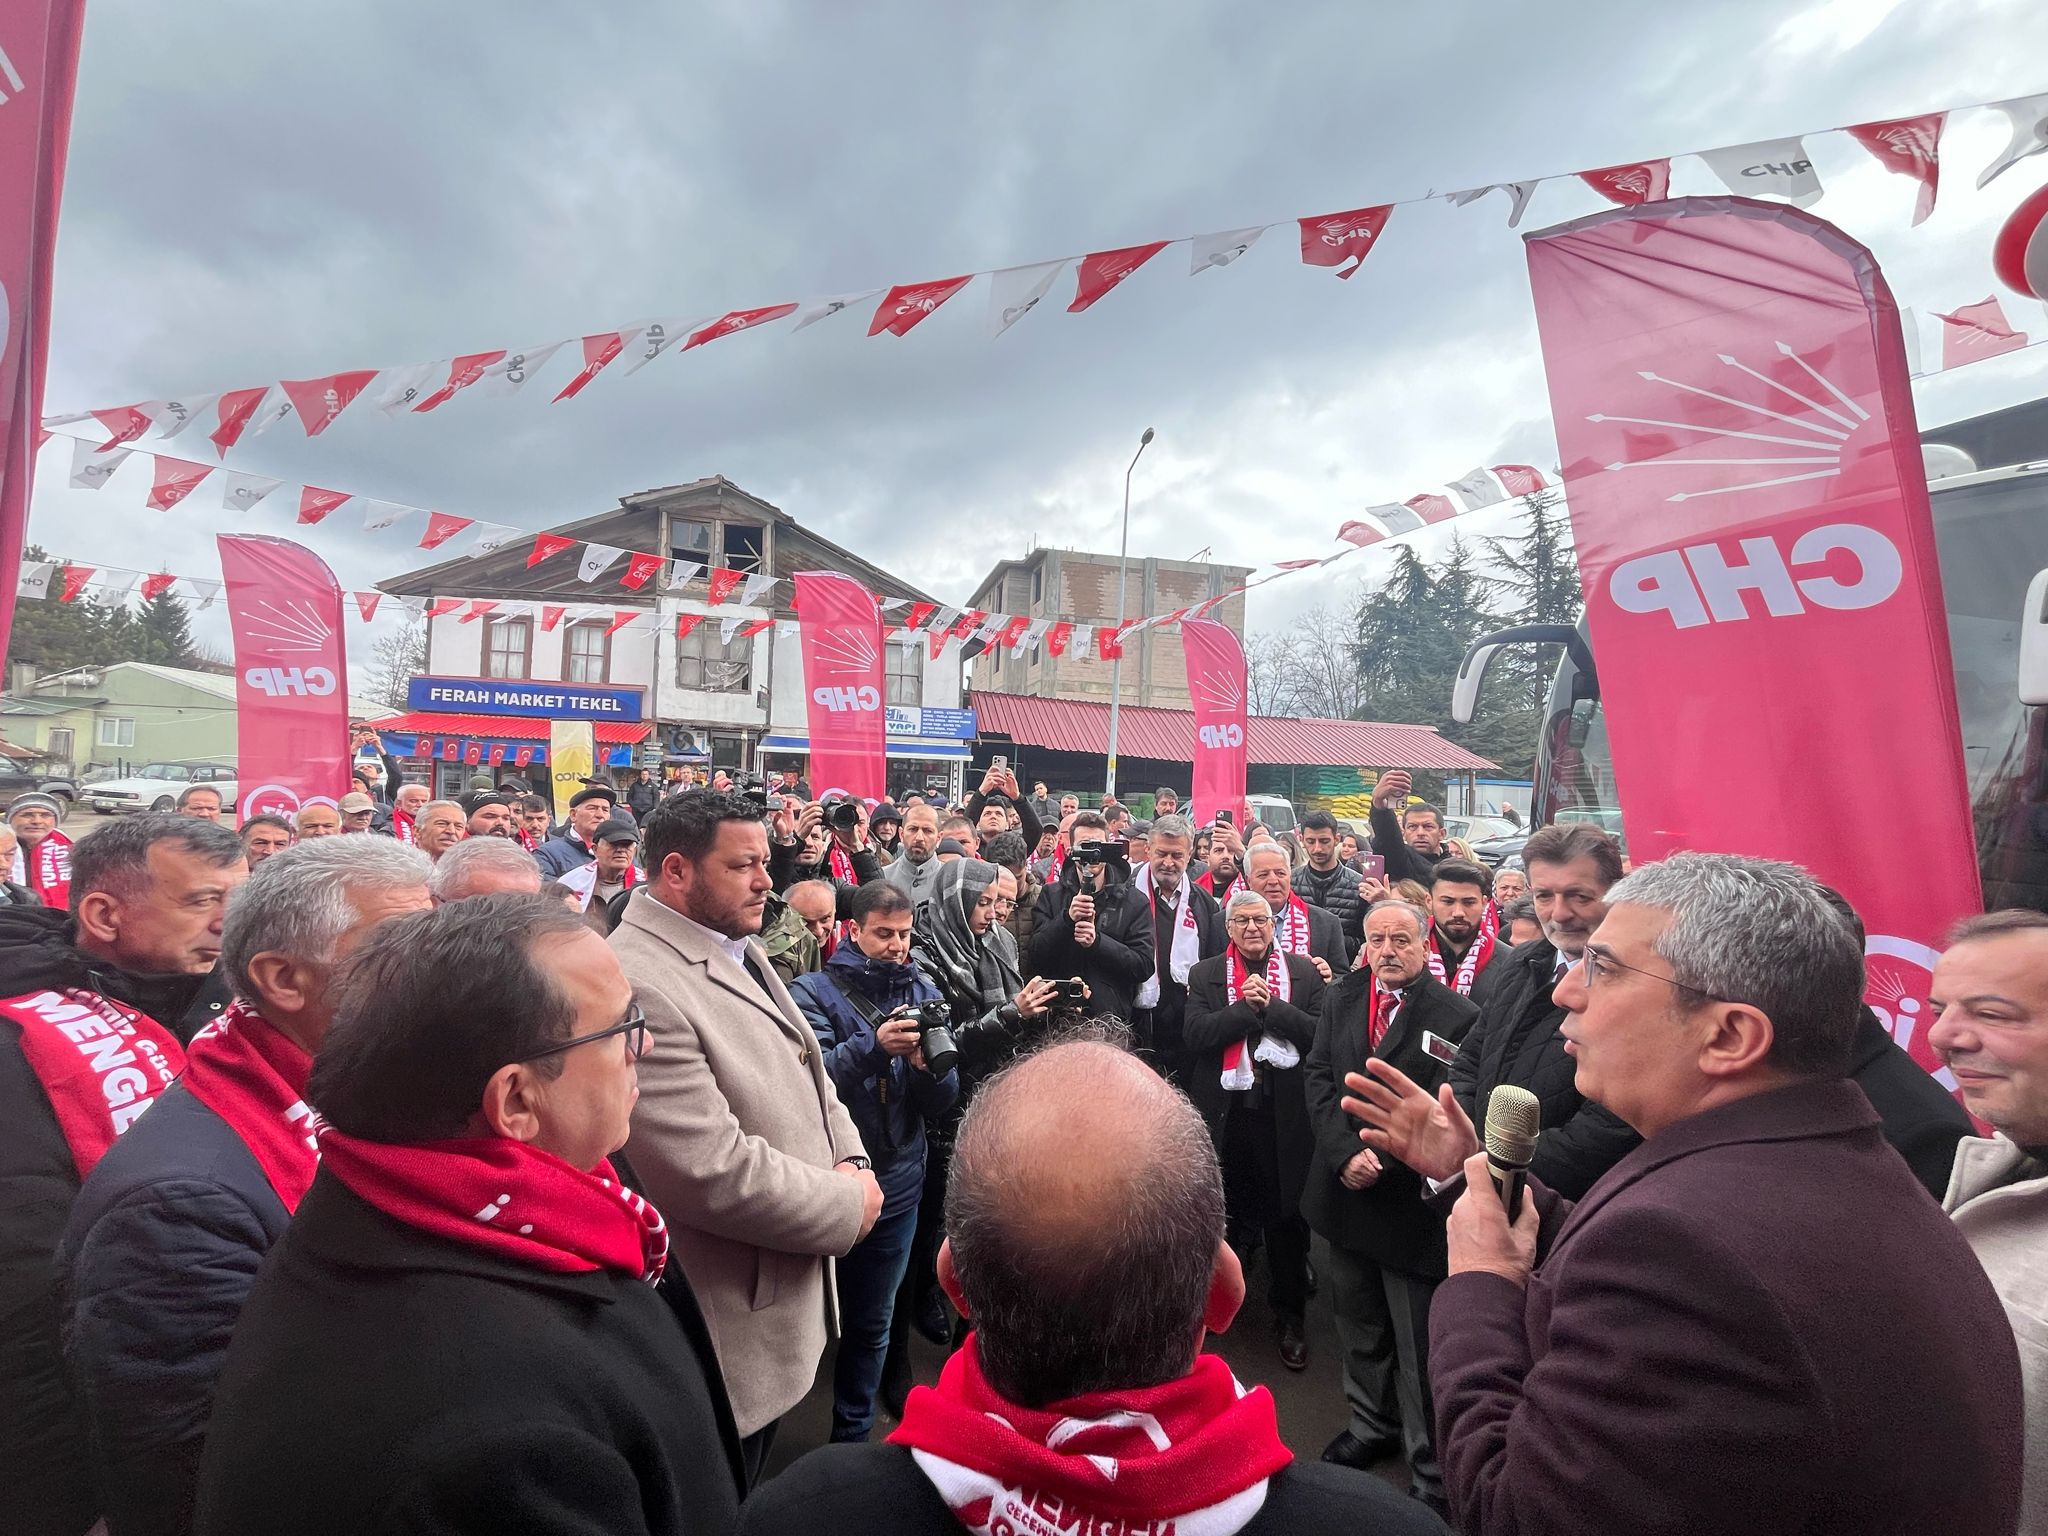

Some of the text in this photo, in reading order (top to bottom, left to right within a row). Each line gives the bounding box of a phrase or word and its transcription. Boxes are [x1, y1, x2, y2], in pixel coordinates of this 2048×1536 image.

[1740, 159, 1814, 178] CHP
[1321, 227, 1372, 247] CHP
[430, 687, 622, 712] FERAH MARKET TEKEL
